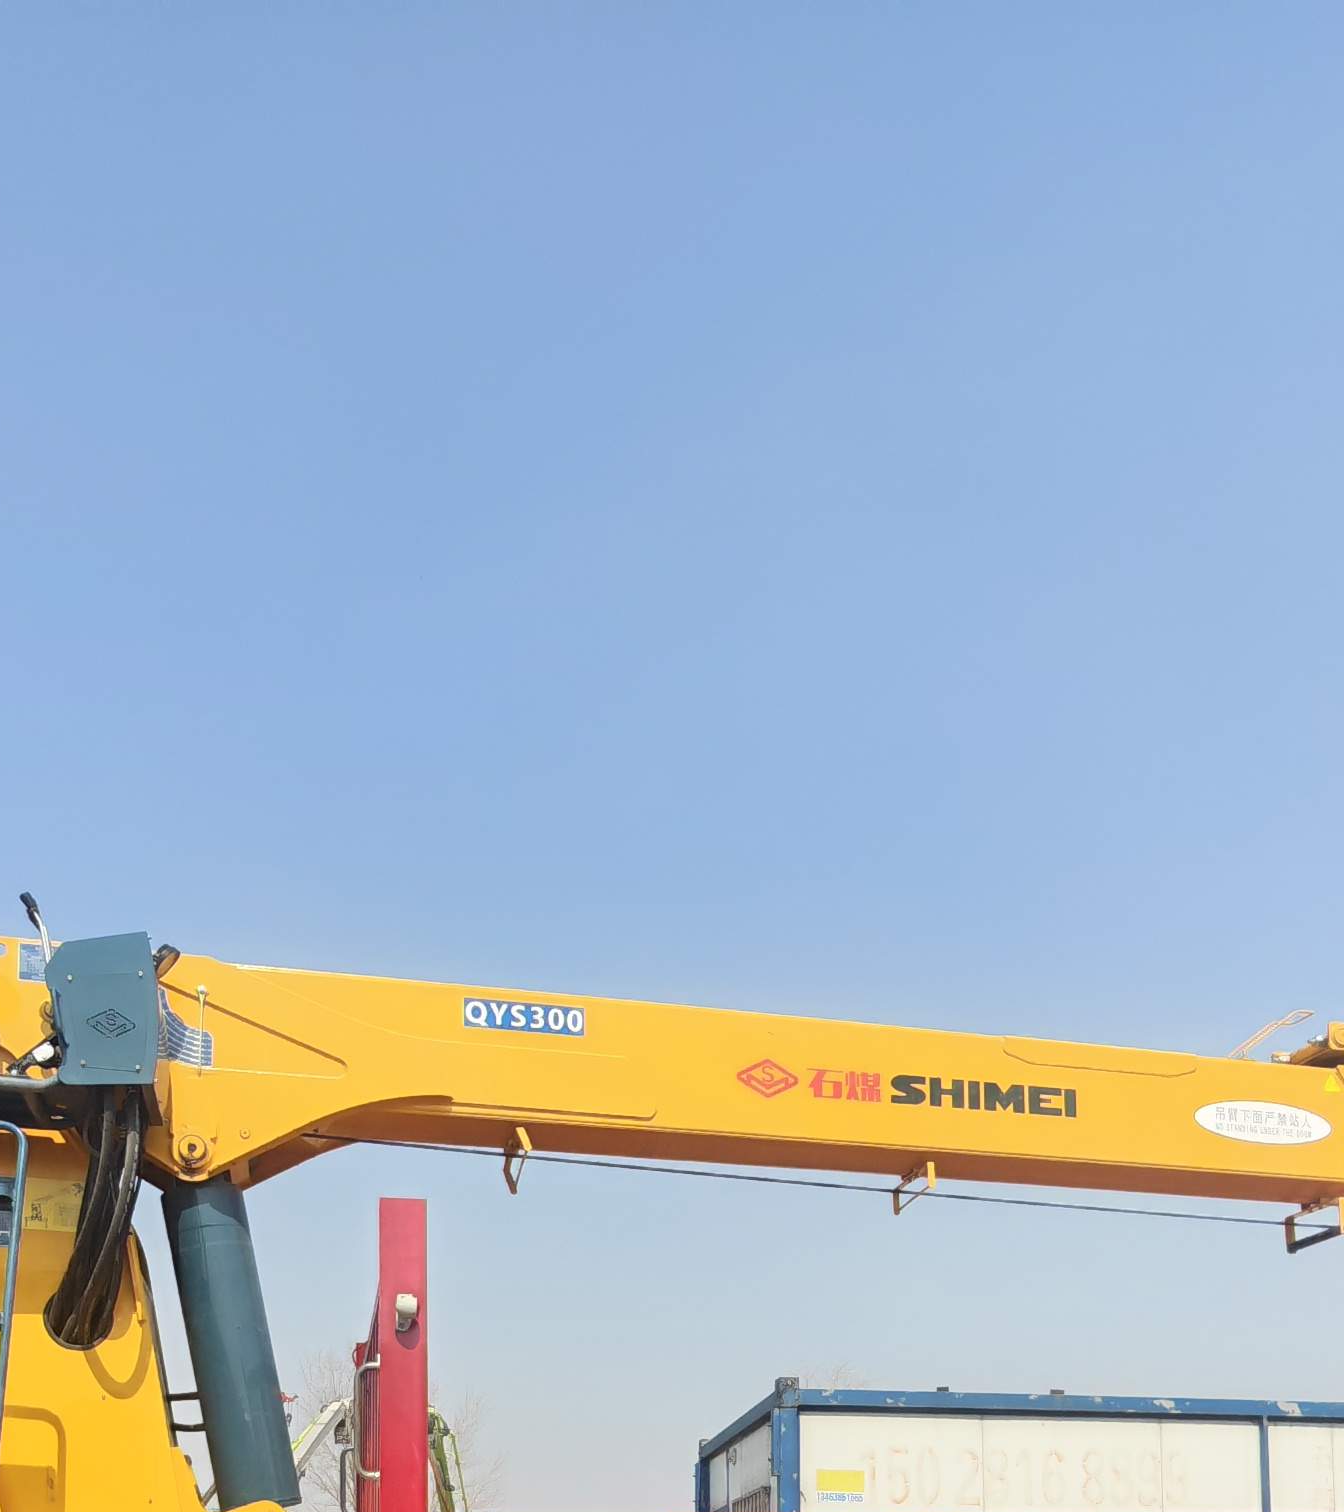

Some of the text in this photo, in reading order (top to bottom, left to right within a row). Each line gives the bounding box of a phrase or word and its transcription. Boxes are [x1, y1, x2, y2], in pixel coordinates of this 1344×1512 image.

[465, 1001, 583, 1033] QYS300
[806, 1067, 882, 1103] 石煤
[890, 1074, 1078, 1118] SHIMEI
[1215, 1106, 1312, 1129] 吊臂下面严禁站人
